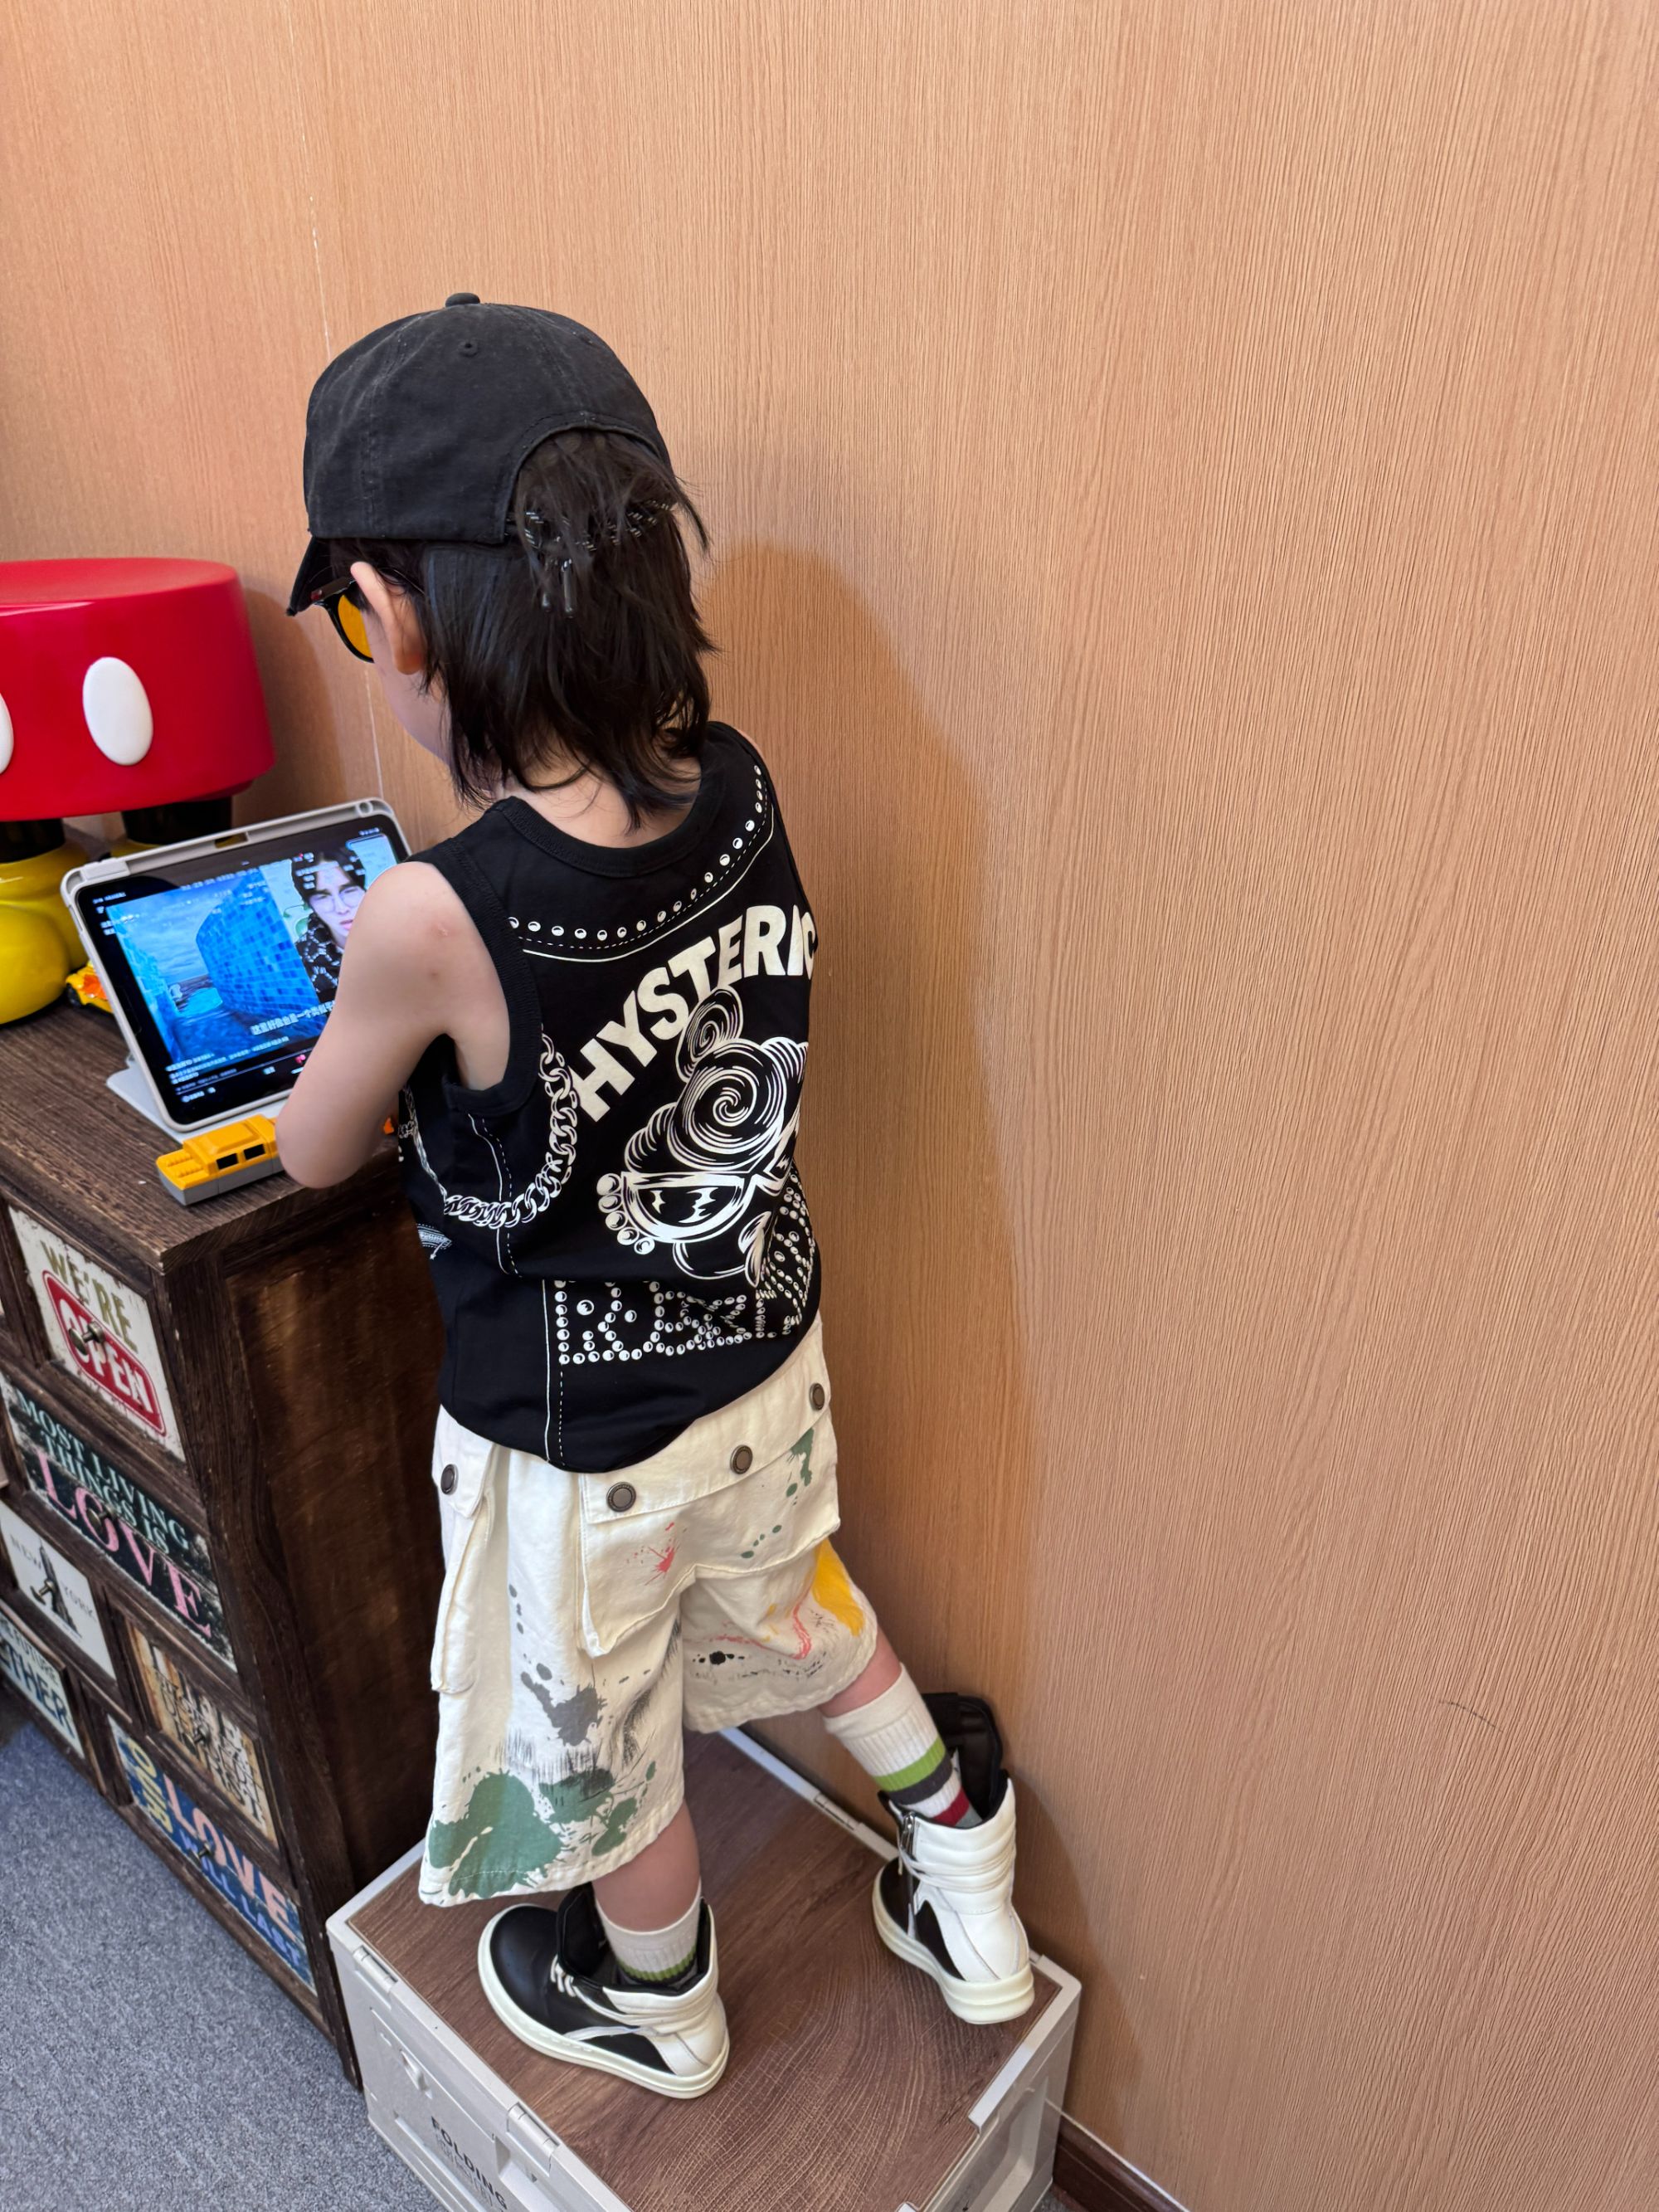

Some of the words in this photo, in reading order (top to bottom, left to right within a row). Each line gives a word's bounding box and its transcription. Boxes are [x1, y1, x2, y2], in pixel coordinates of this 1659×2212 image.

[568, 904, 815, 1122] HYSTERIC
[40, 1240, 138, 1354] WE'RE
[60, 1298, 153, 1414] OPEN
[17, 1389, 84, 1462] MOST
[92, 1452, 189, 1550] LIVING
[41, 1430, 137, 1527] THINGS
[142, 1515, 169, 1554] IS
[36, 1448, 212, 1638] LOVE
[163, 1772, 297, 1943] LOVE
[241, 1893, 299, 1966] LAST
[431, 2115, 507, 2210] FOLDING
